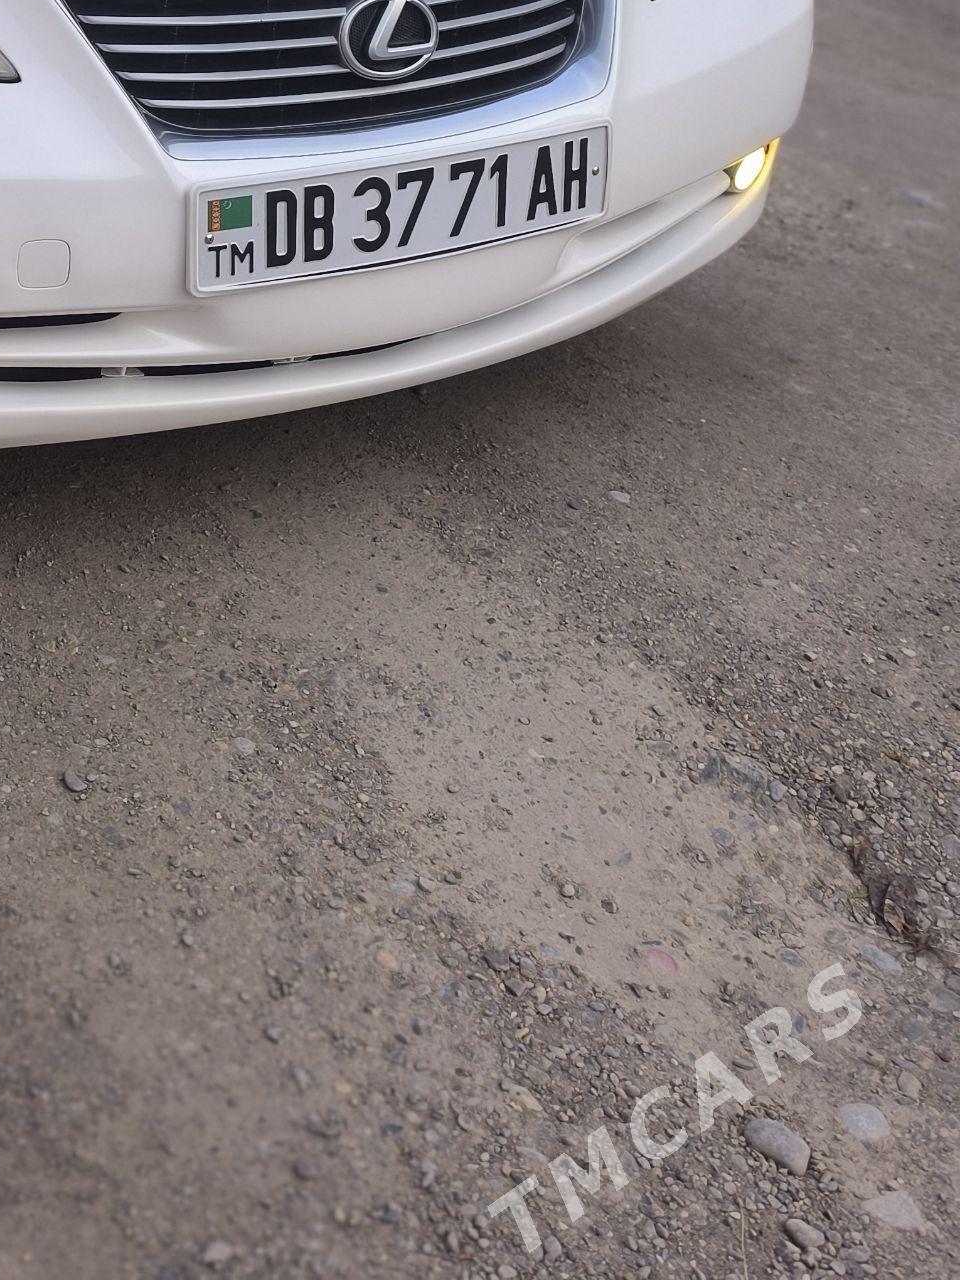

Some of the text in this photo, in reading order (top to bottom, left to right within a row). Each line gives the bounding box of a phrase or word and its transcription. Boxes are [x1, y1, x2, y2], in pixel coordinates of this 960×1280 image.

[265, 137, 589, 269] DB 37 71 AH
[207, 241, 254, 278] TM
